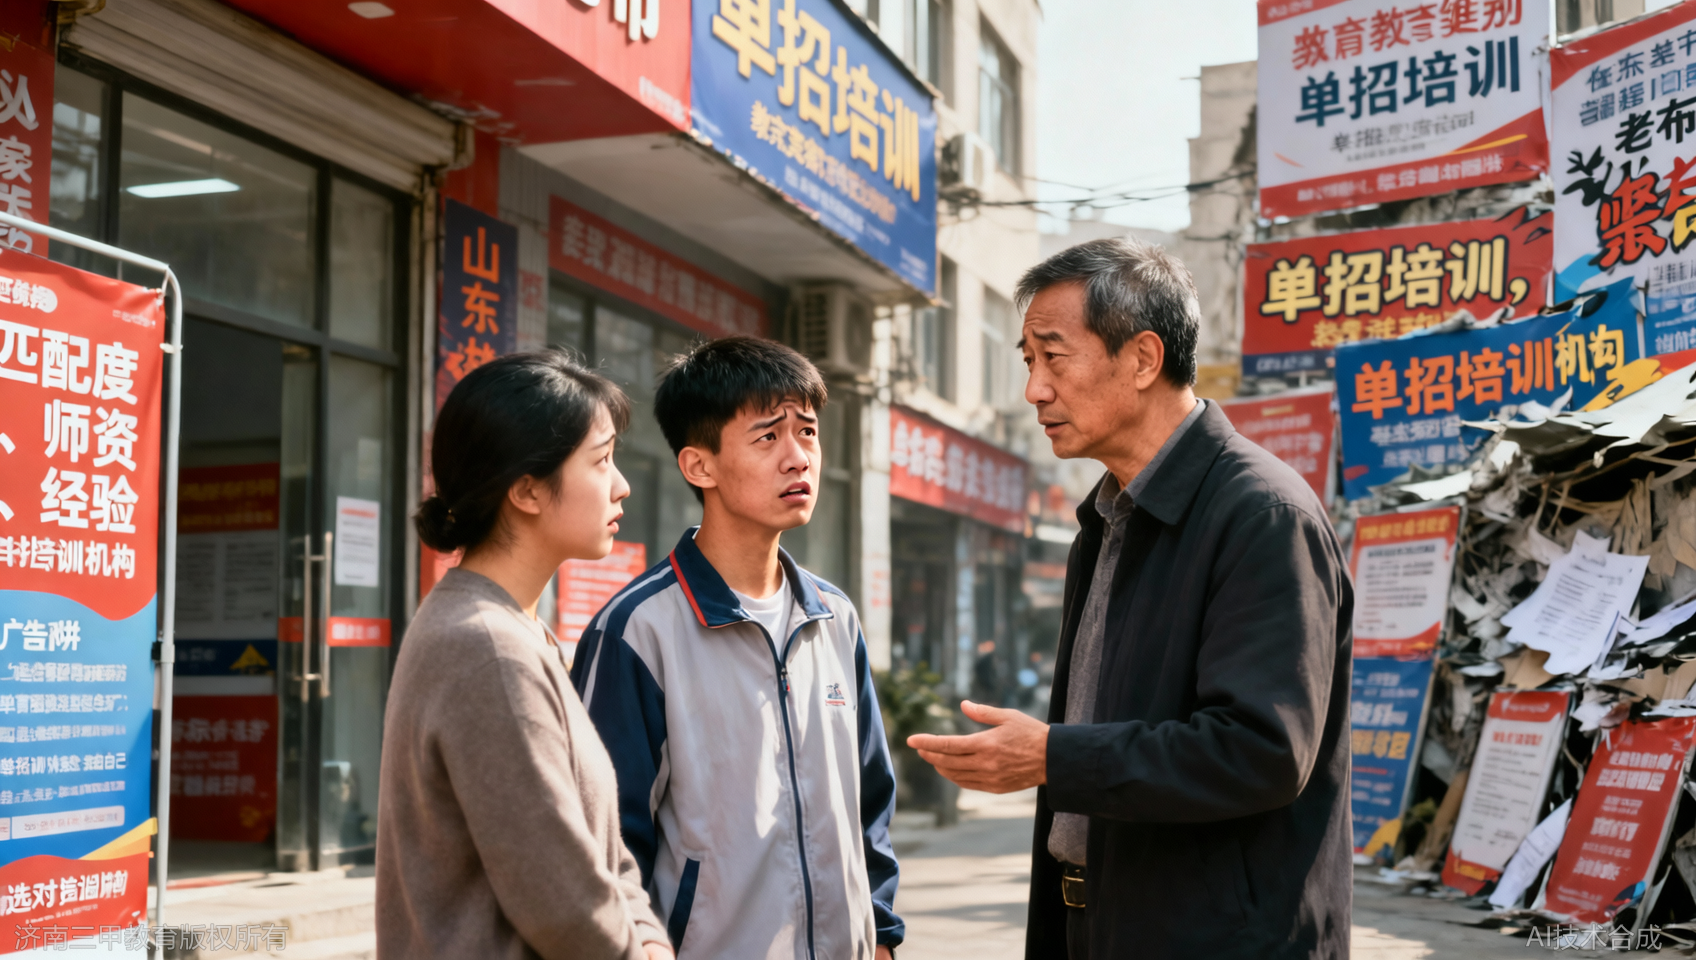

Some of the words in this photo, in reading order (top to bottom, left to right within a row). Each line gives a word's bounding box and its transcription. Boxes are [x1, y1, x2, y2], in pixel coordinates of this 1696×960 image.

[712, 0, 921, 203] 单招培训
[1295, 35, 1520, 127] 单招培训
[0, 319, 139, 405] 匹配度
[1351, 323, 1625, 420] 单招培训机构
